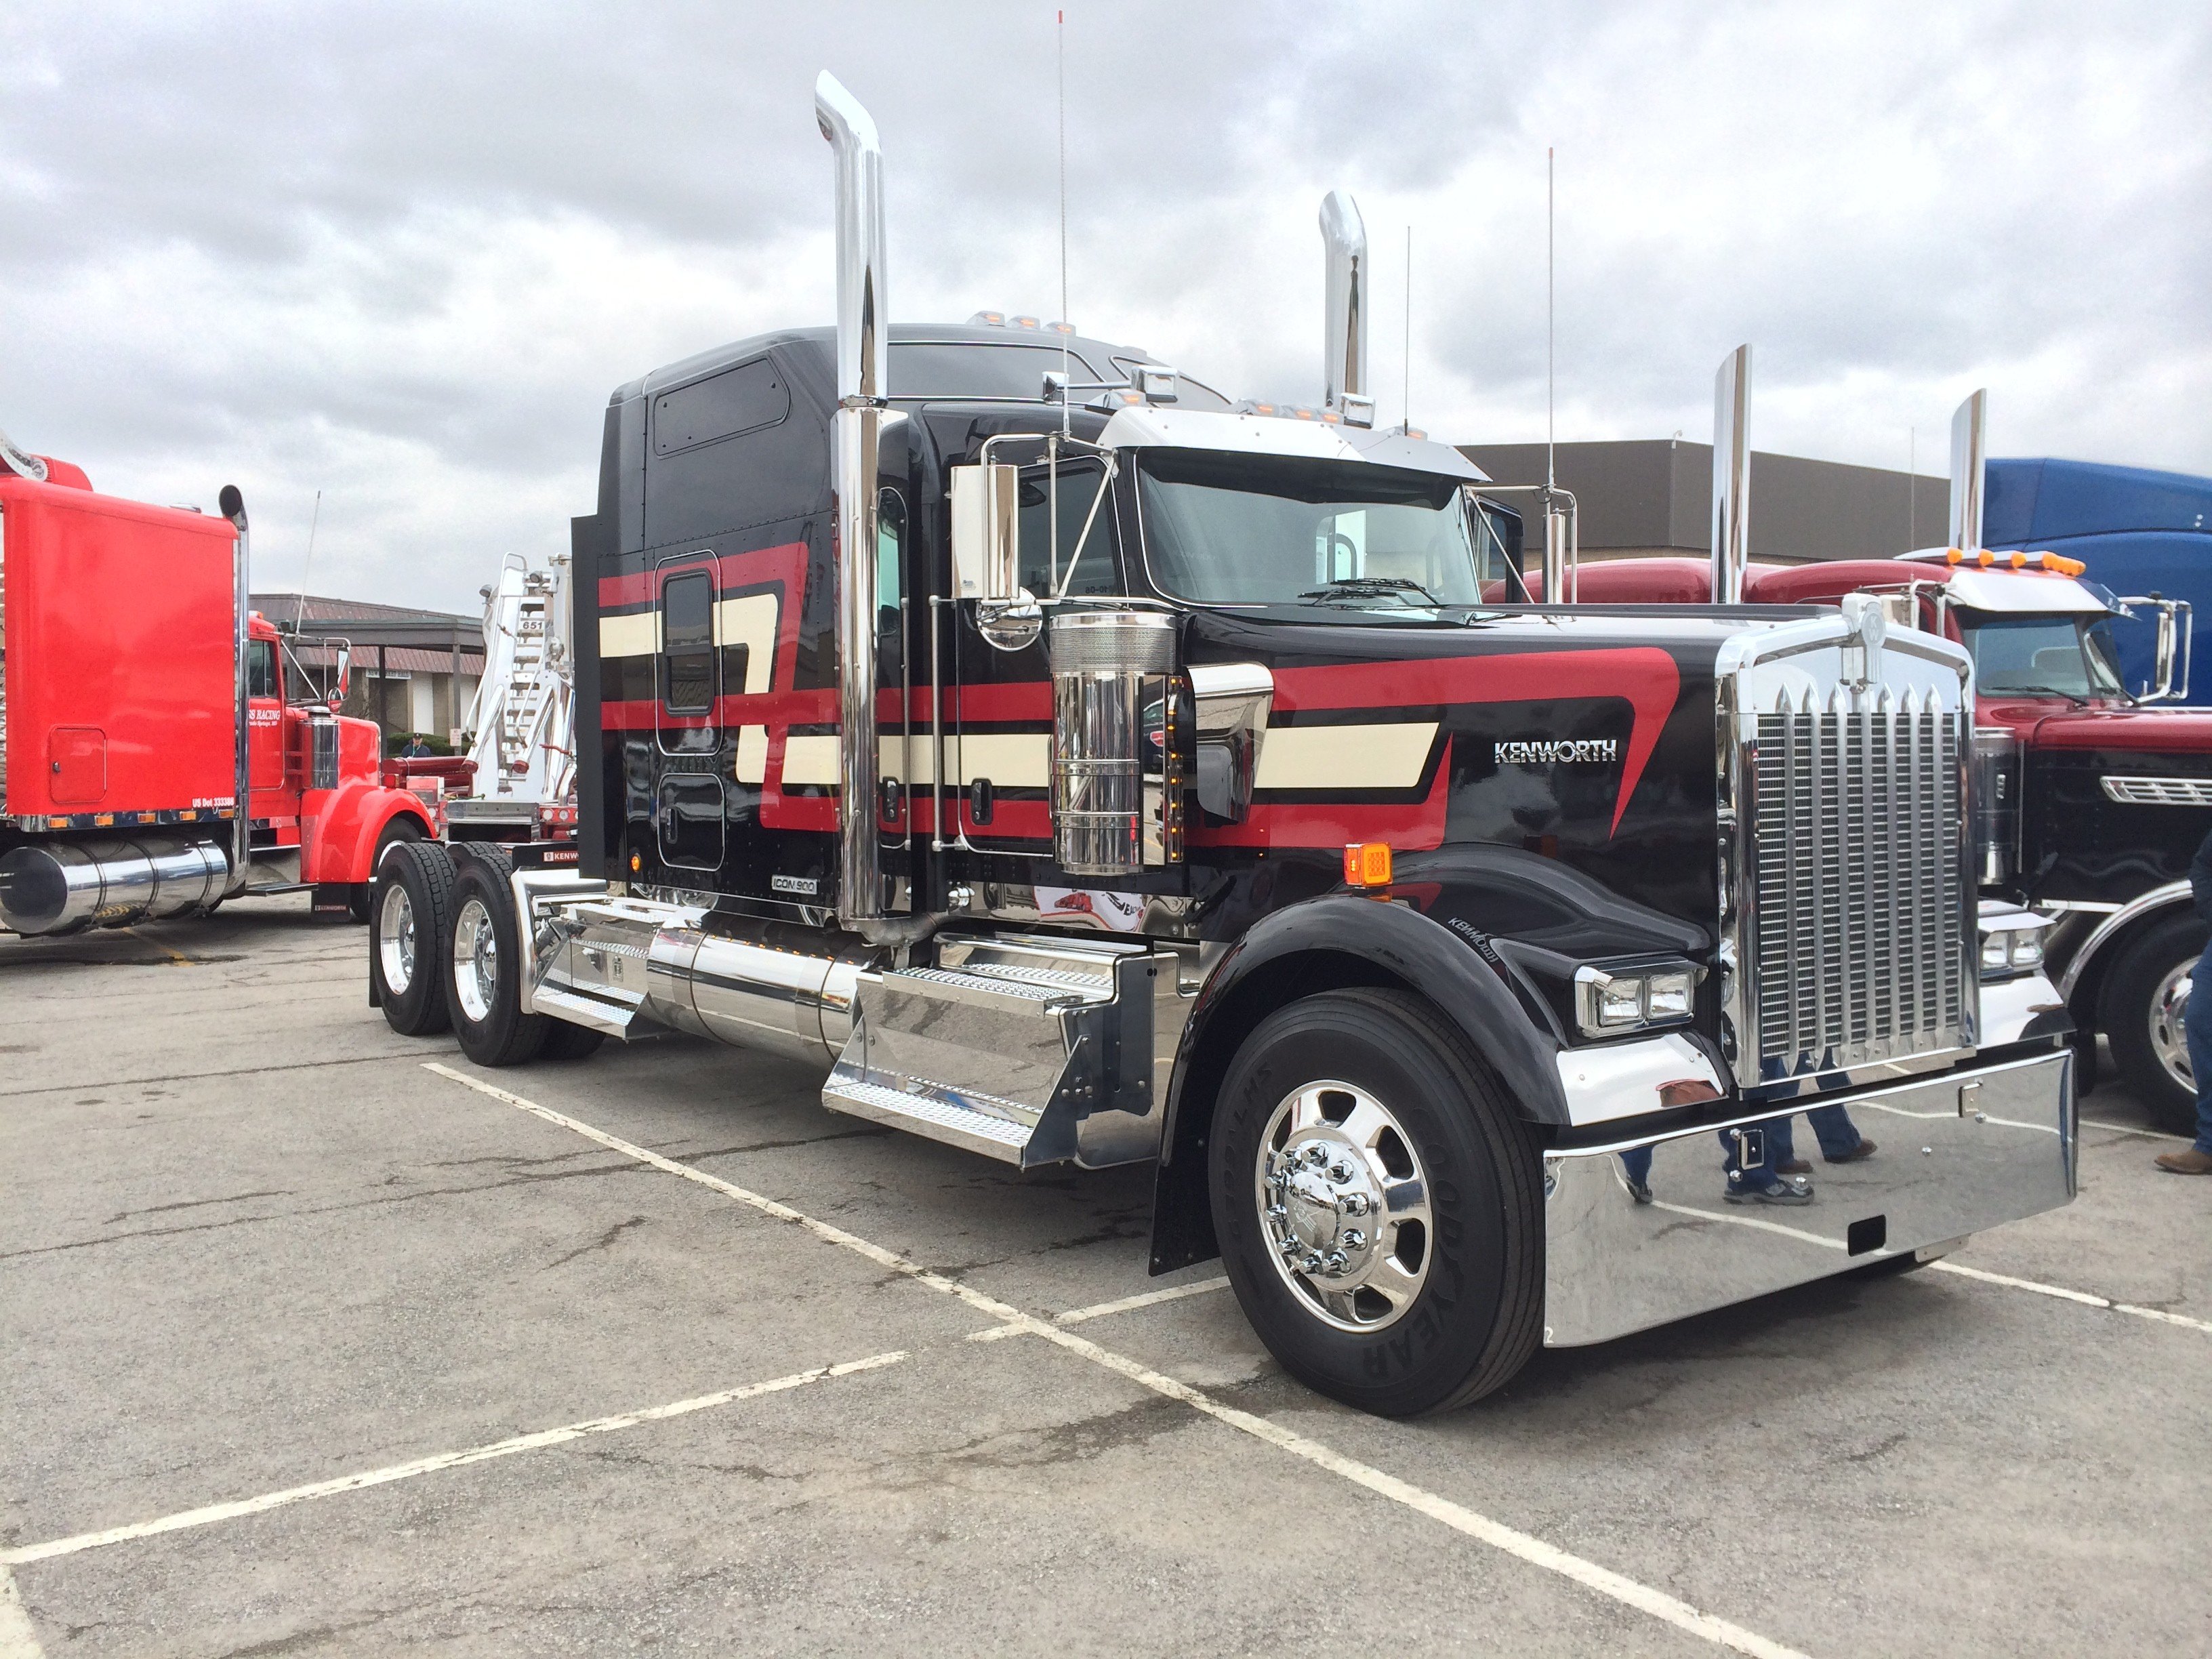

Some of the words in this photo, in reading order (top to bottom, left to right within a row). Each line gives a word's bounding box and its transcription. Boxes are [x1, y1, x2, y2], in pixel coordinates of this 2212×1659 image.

[523, 621, 542, 630] 651
[255, 710, 281, 720] RACING
[1494, 739, 1616, 764] KENWORTH
[192, 798, 201, 808] US
[773, 878, 795, 889] ICON
[796, 880, 815, 892] 900
